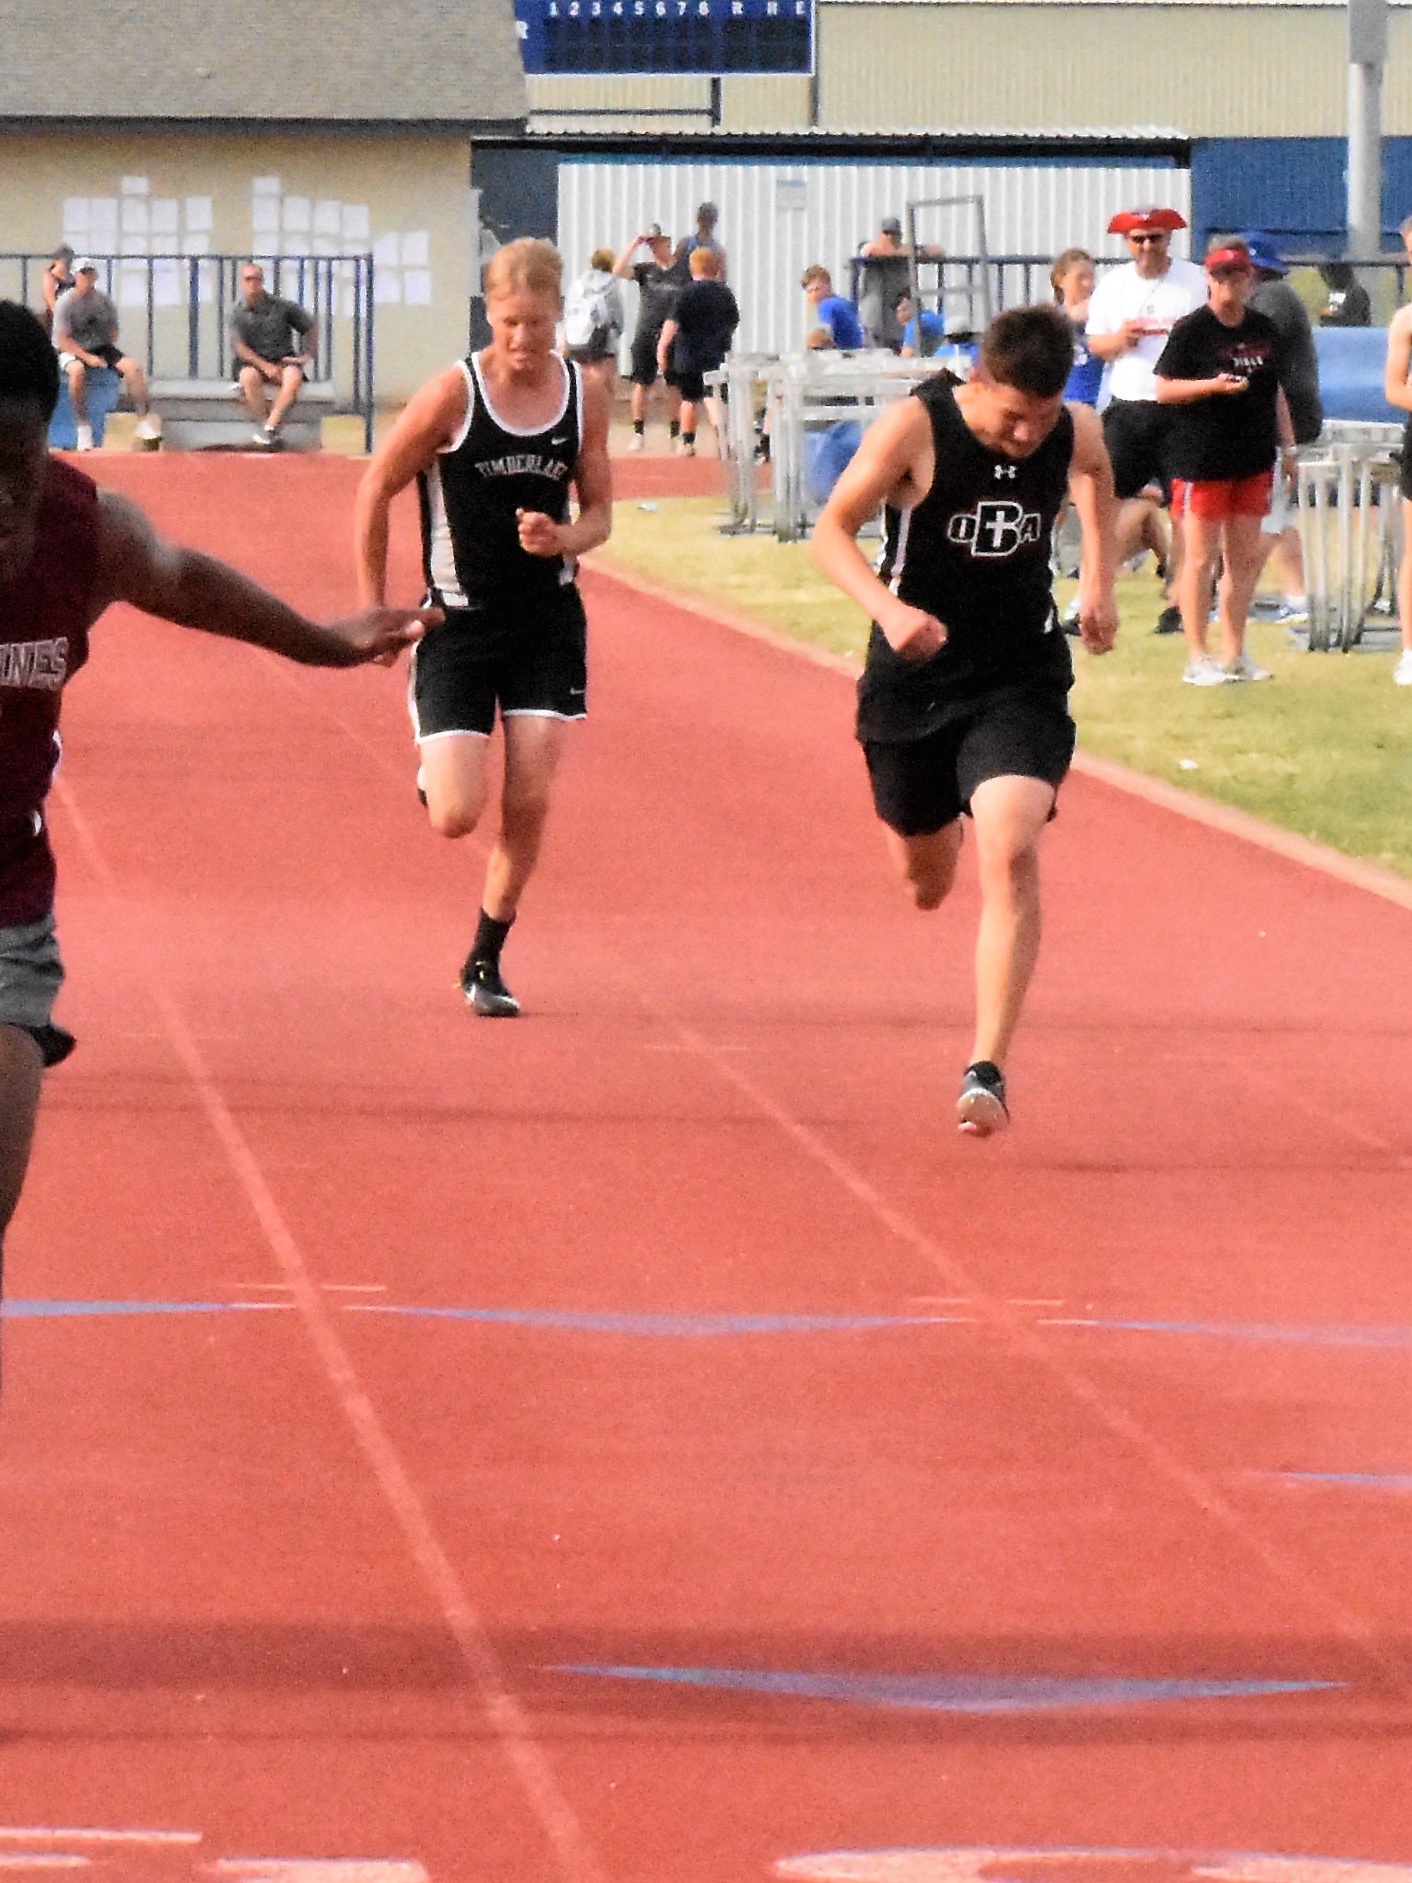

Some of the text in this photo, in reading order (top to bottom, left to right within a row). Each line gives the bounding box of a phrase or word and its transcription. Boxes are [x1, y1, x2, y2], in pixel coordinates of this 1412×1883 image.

[550, 1, 558, 16] 1
[568, 1, 580, 16] 2
[591, 1, 602, 16] 3
[613, 1, 624, 16] 4
[634, 1, 645, 16] 5
[655, 1, 667, 16] 6
[677, 1, 687, 16] 7
[699, 1, 710, 16] 8
